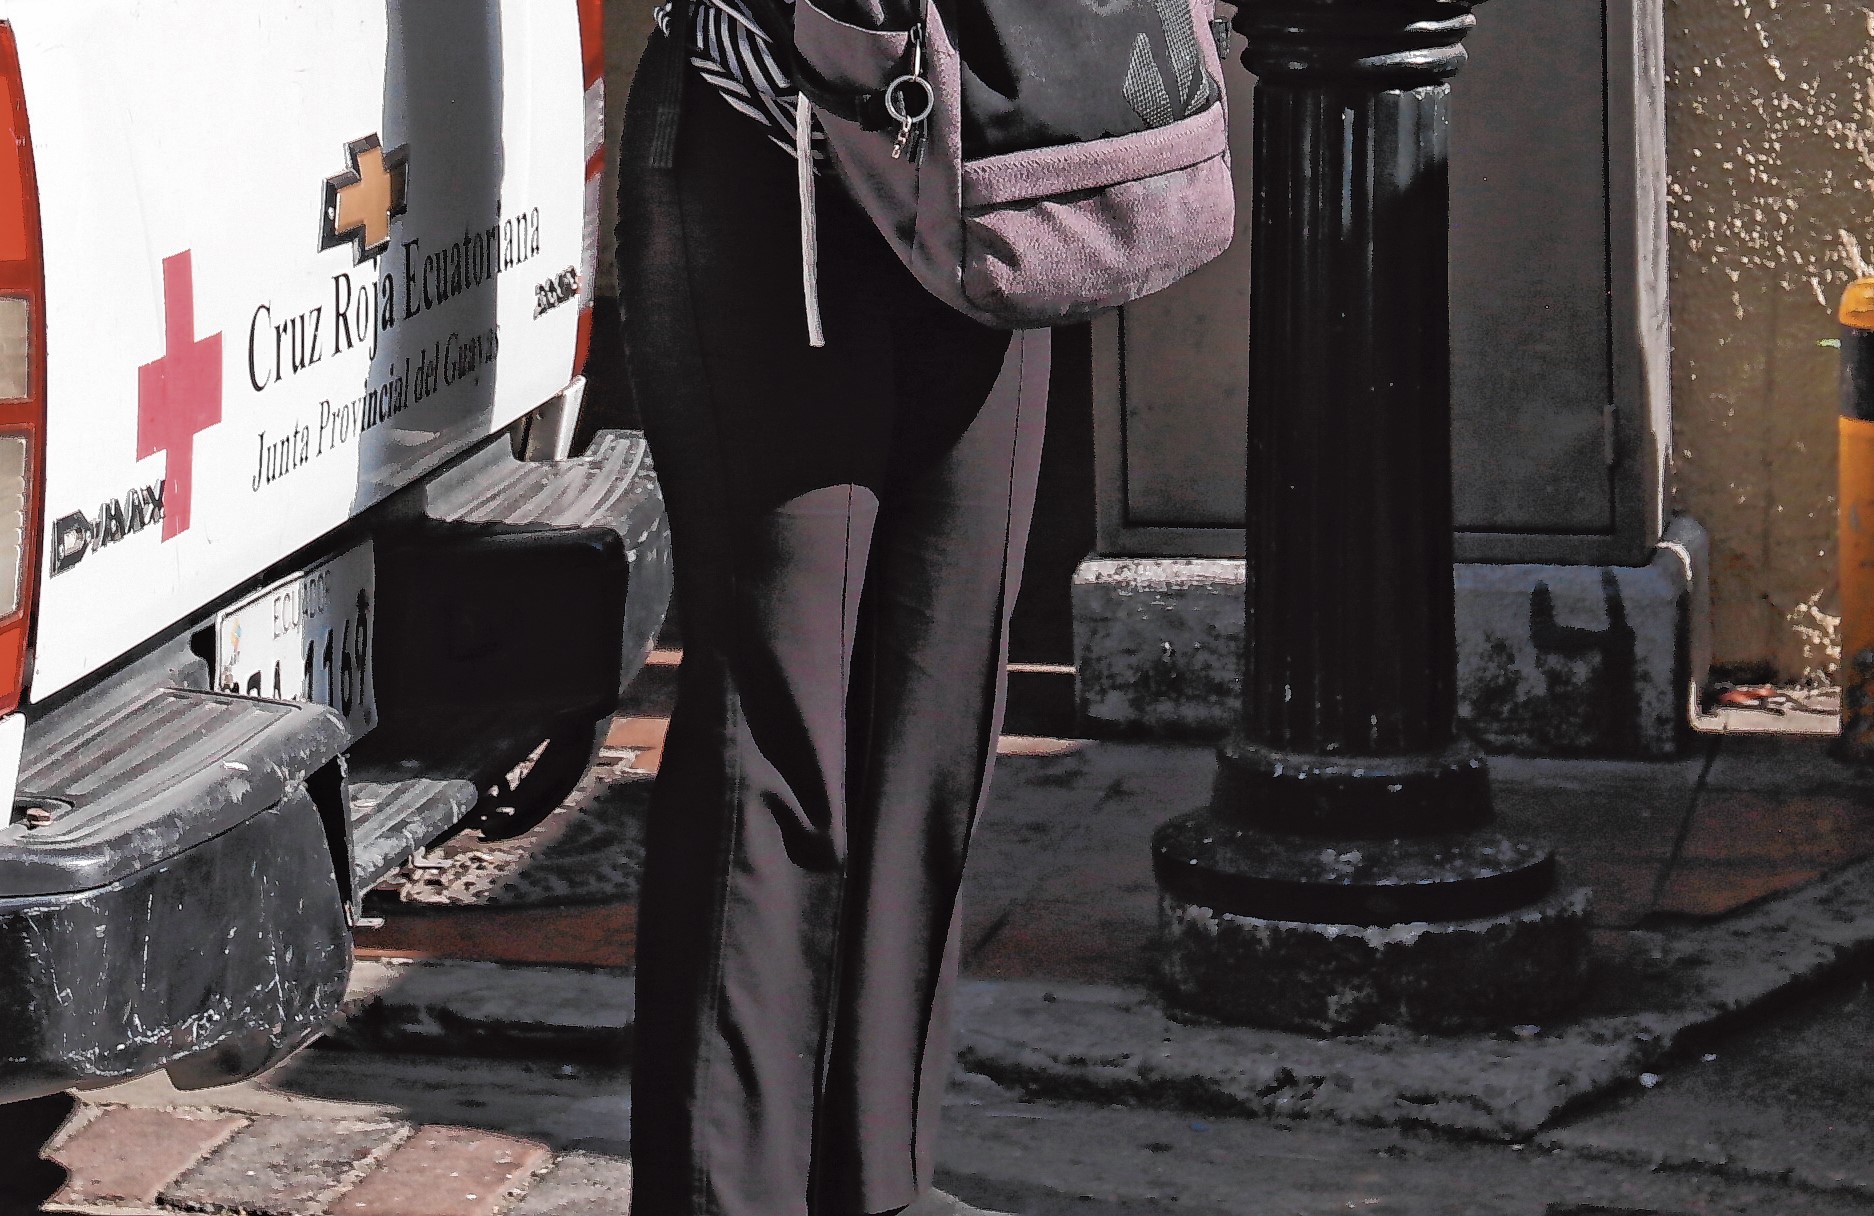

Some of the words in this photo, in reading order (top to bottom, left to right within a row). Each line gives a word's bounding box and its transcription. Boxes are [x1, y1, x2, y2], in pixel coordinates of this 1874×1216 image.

[249, 300, 322, 392] Cruz
[331, 256, 395, 362] Roja
[402, 200, 540, 320] Ecuatoriana
[251, 418, 309, 492] Junta
[316, 357, 410, 457] Provincial
[414, 341, 440, 403] del
